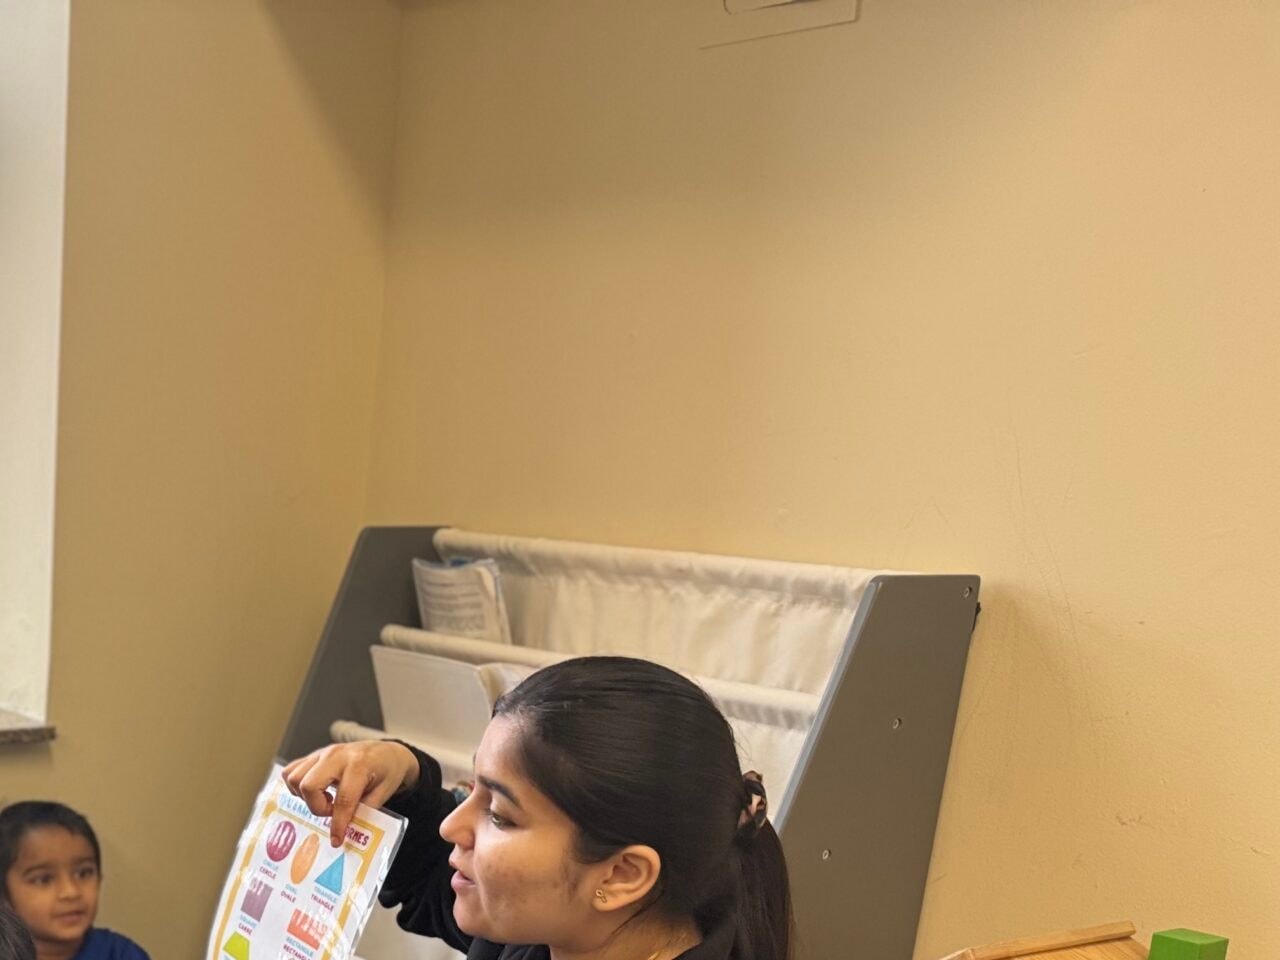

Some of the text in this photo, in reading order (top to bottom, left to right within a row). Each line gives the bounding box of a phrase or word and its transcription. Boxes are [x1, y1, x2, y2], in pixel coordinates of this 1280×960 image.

[260, 866, 277, 880] CERCLE
[280, 890, 296, 903] OVALE
[311, 894, 334, 912] TRIANGLE
